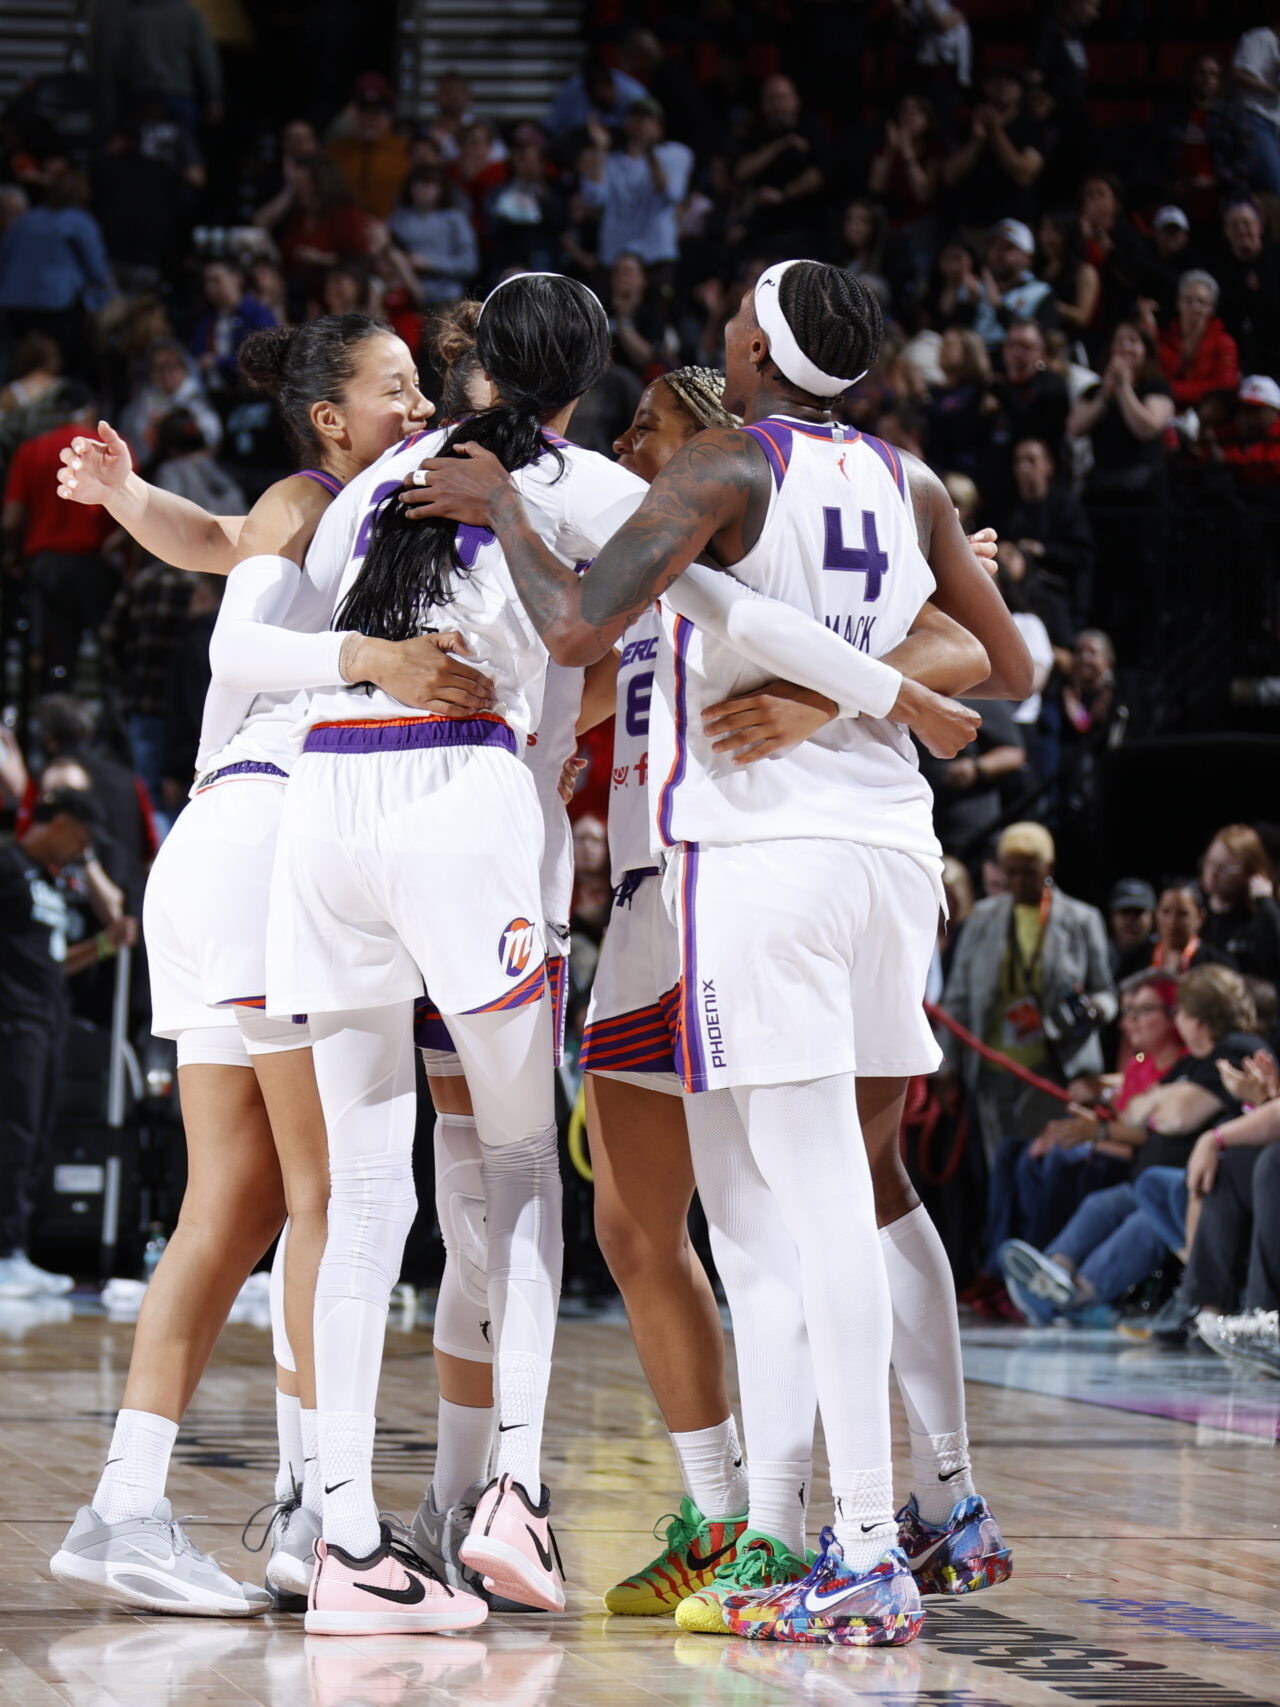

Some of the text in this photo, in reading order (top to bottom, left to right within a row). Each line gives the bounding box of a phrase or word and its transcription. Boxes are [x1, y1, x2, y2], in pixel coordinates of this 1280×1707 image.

[823, 506, 889, 602] 4
[621, 637, 660, 668] ERC
[702, 979, 727, 1068] PHOENIX
